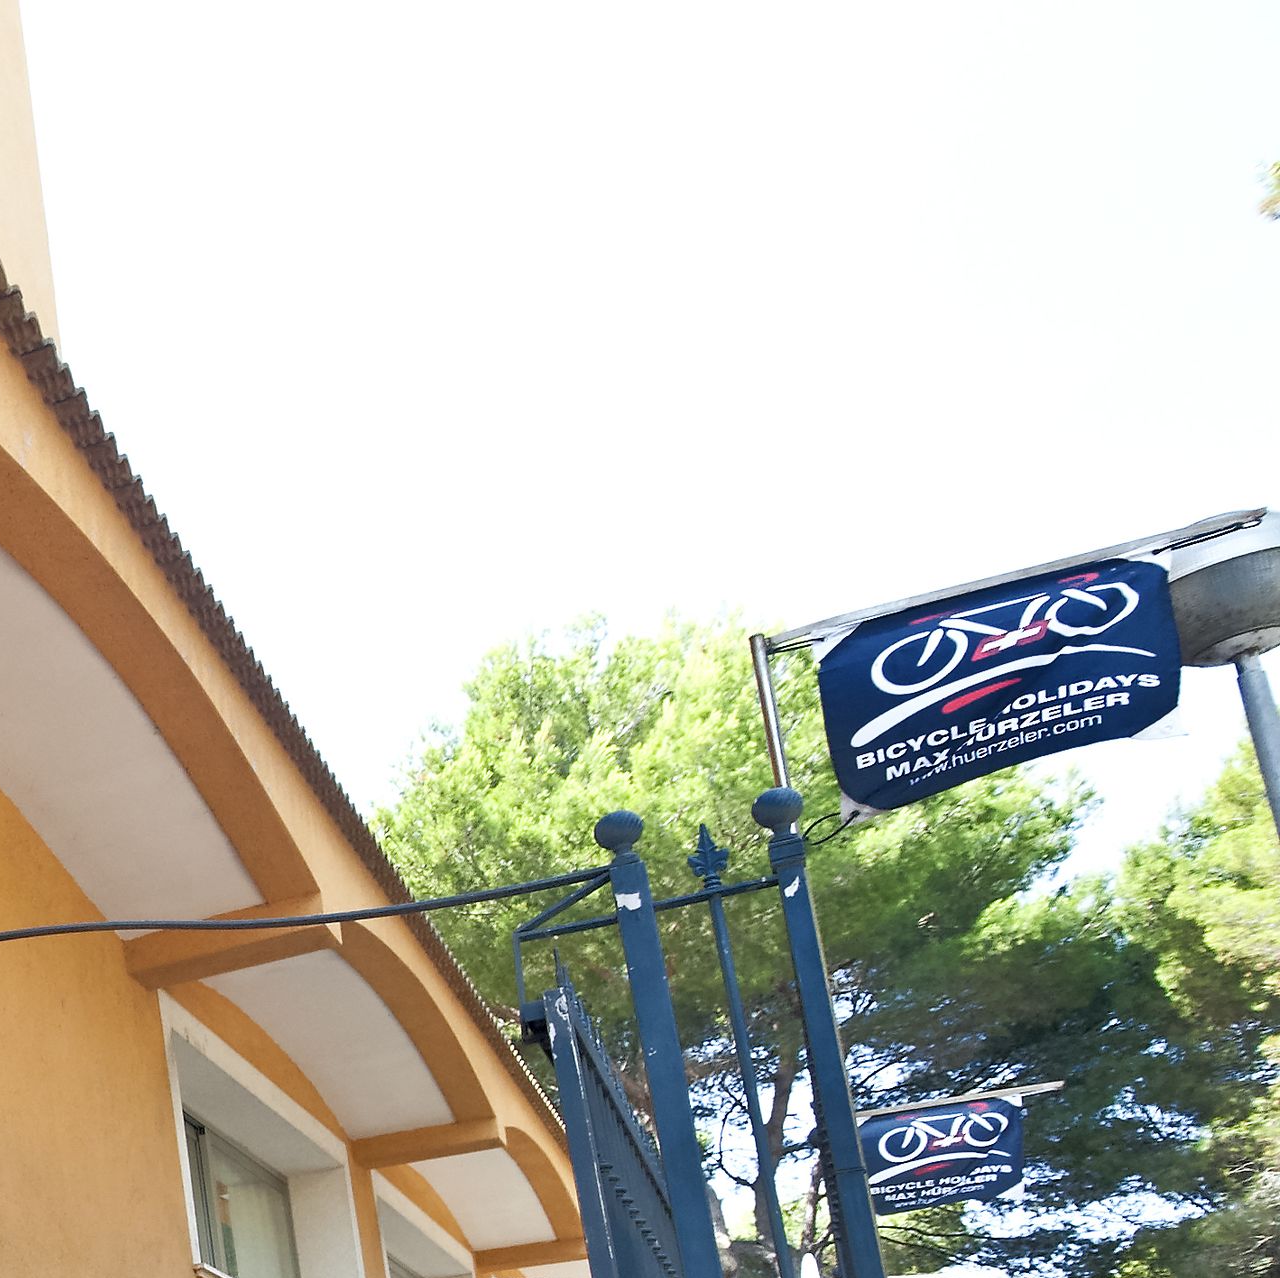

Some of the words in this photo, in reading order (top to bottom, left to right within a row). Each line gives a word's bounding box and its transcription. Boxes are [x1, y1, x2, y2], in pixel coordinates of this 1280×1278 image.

[855, 717, 987, 770] BICYCLE
[1000, 673, 1162, 718] OLIDAYS
[957, 692, 1130, 750] ÜRZELER
[870, 1180, 935, 1195] BICYCLE
